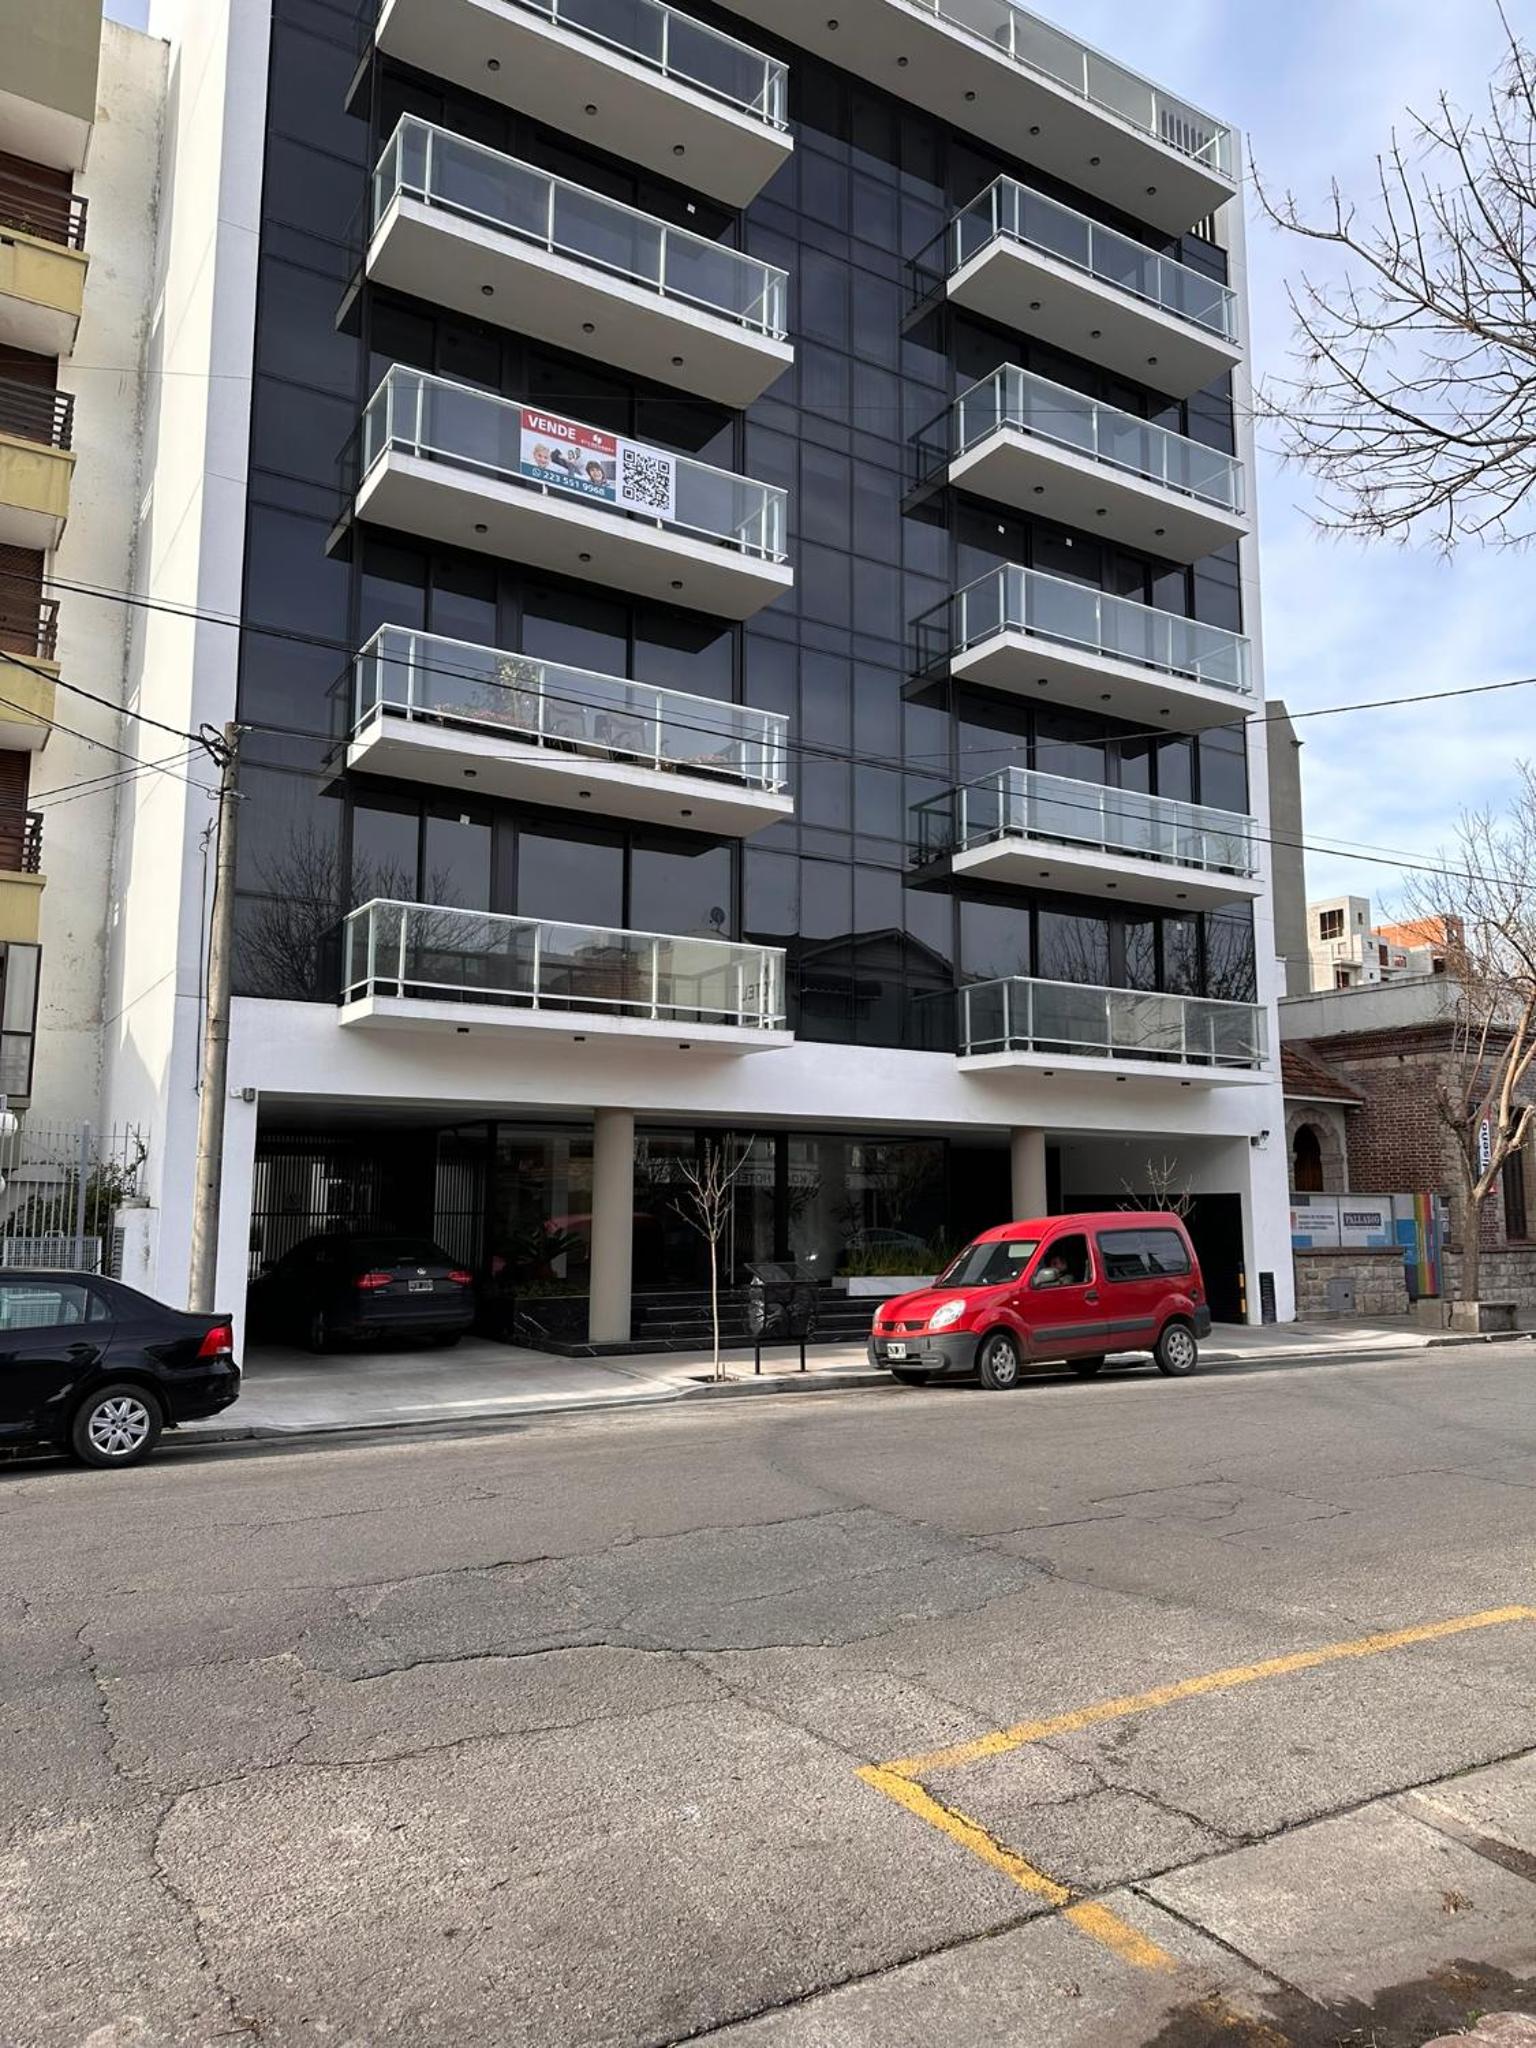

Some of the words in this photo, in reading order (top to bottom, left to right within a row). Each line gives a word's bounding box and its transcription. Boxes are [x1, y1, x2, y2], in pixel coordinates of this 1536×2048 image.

[528, 415, 576, 440] VENDE
[543, 471, 560, 483] 223
[563, 476, 579, 488] 551
